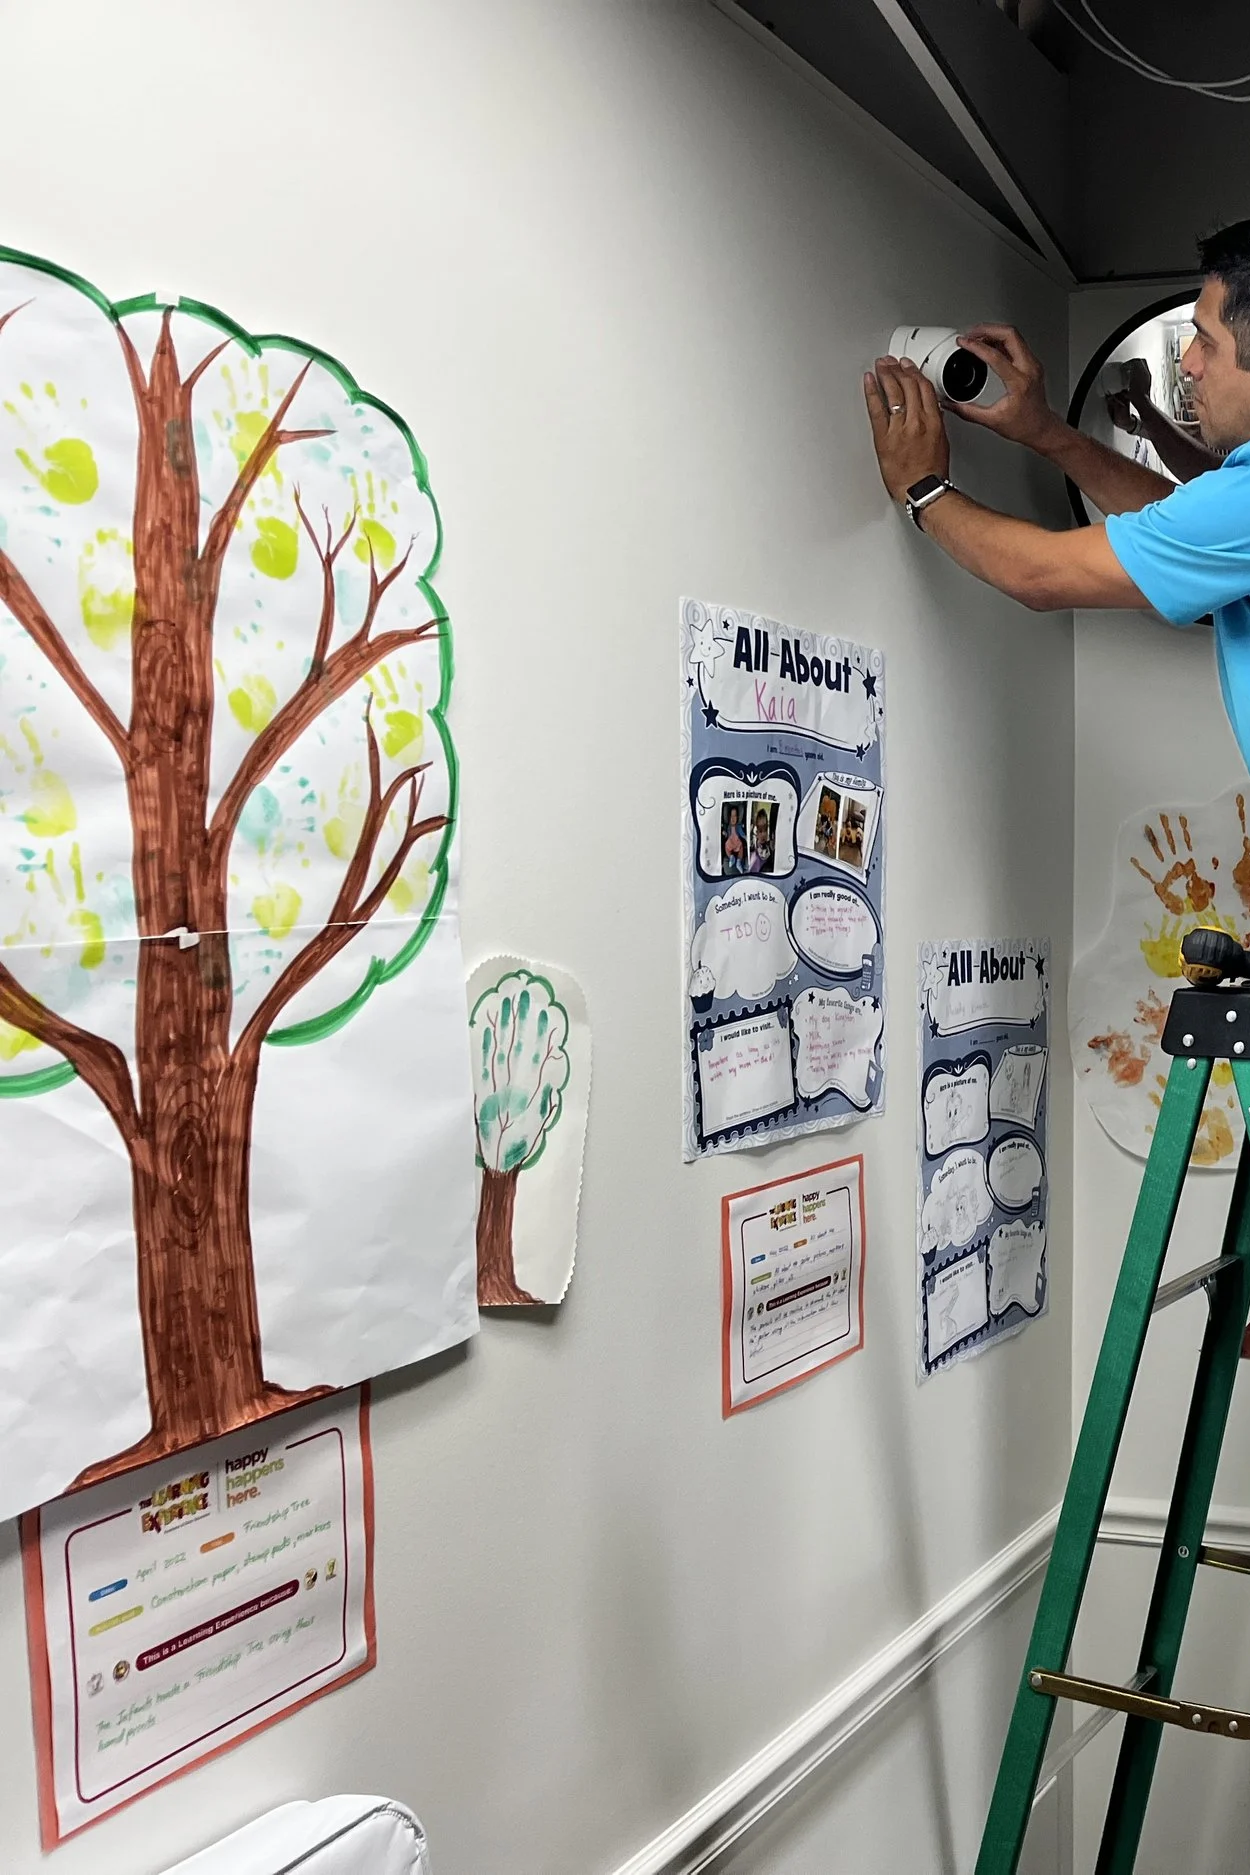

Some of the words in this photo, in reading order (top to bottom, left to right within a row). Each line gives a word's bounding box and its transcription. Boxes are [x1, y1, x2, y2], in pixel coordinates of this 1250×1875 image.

[733, 626, 770, 673] All
[780, 638, 852, 693] About
[755, 678, 797, 723] Kaia
[747, 890, 761, 901] want
[761, 891, 767, 901] to
[821, 890, 836, 900] really
[836, 892, 851, 902] good
[720, 921, 752, 942] TBD
[947, 949, 972, 987] All
[979, 947, 1026, 985] About
[724, 1030, 740, 1041] would
[741, 1028, 751, 1036] like
[802, 1190, 820, 1203] happy
[802, 1199, 826, 1213] happens
[225, 1447, 269, 1474] happy
[225, 1458, 285, 1492] happens
[226, 1486, 261, 1509] here.
[291, 1498, 311, 1512] Tree
[135, 1559, 158, 1582] April
[143, 1651, 161, 1665] This
[162, 1646, 170, 1656] is
[170, 1643, 177, 1652] a
[177, 1624, 214, 1648] Learning
[215, 1604, 259, 1631] Experience
